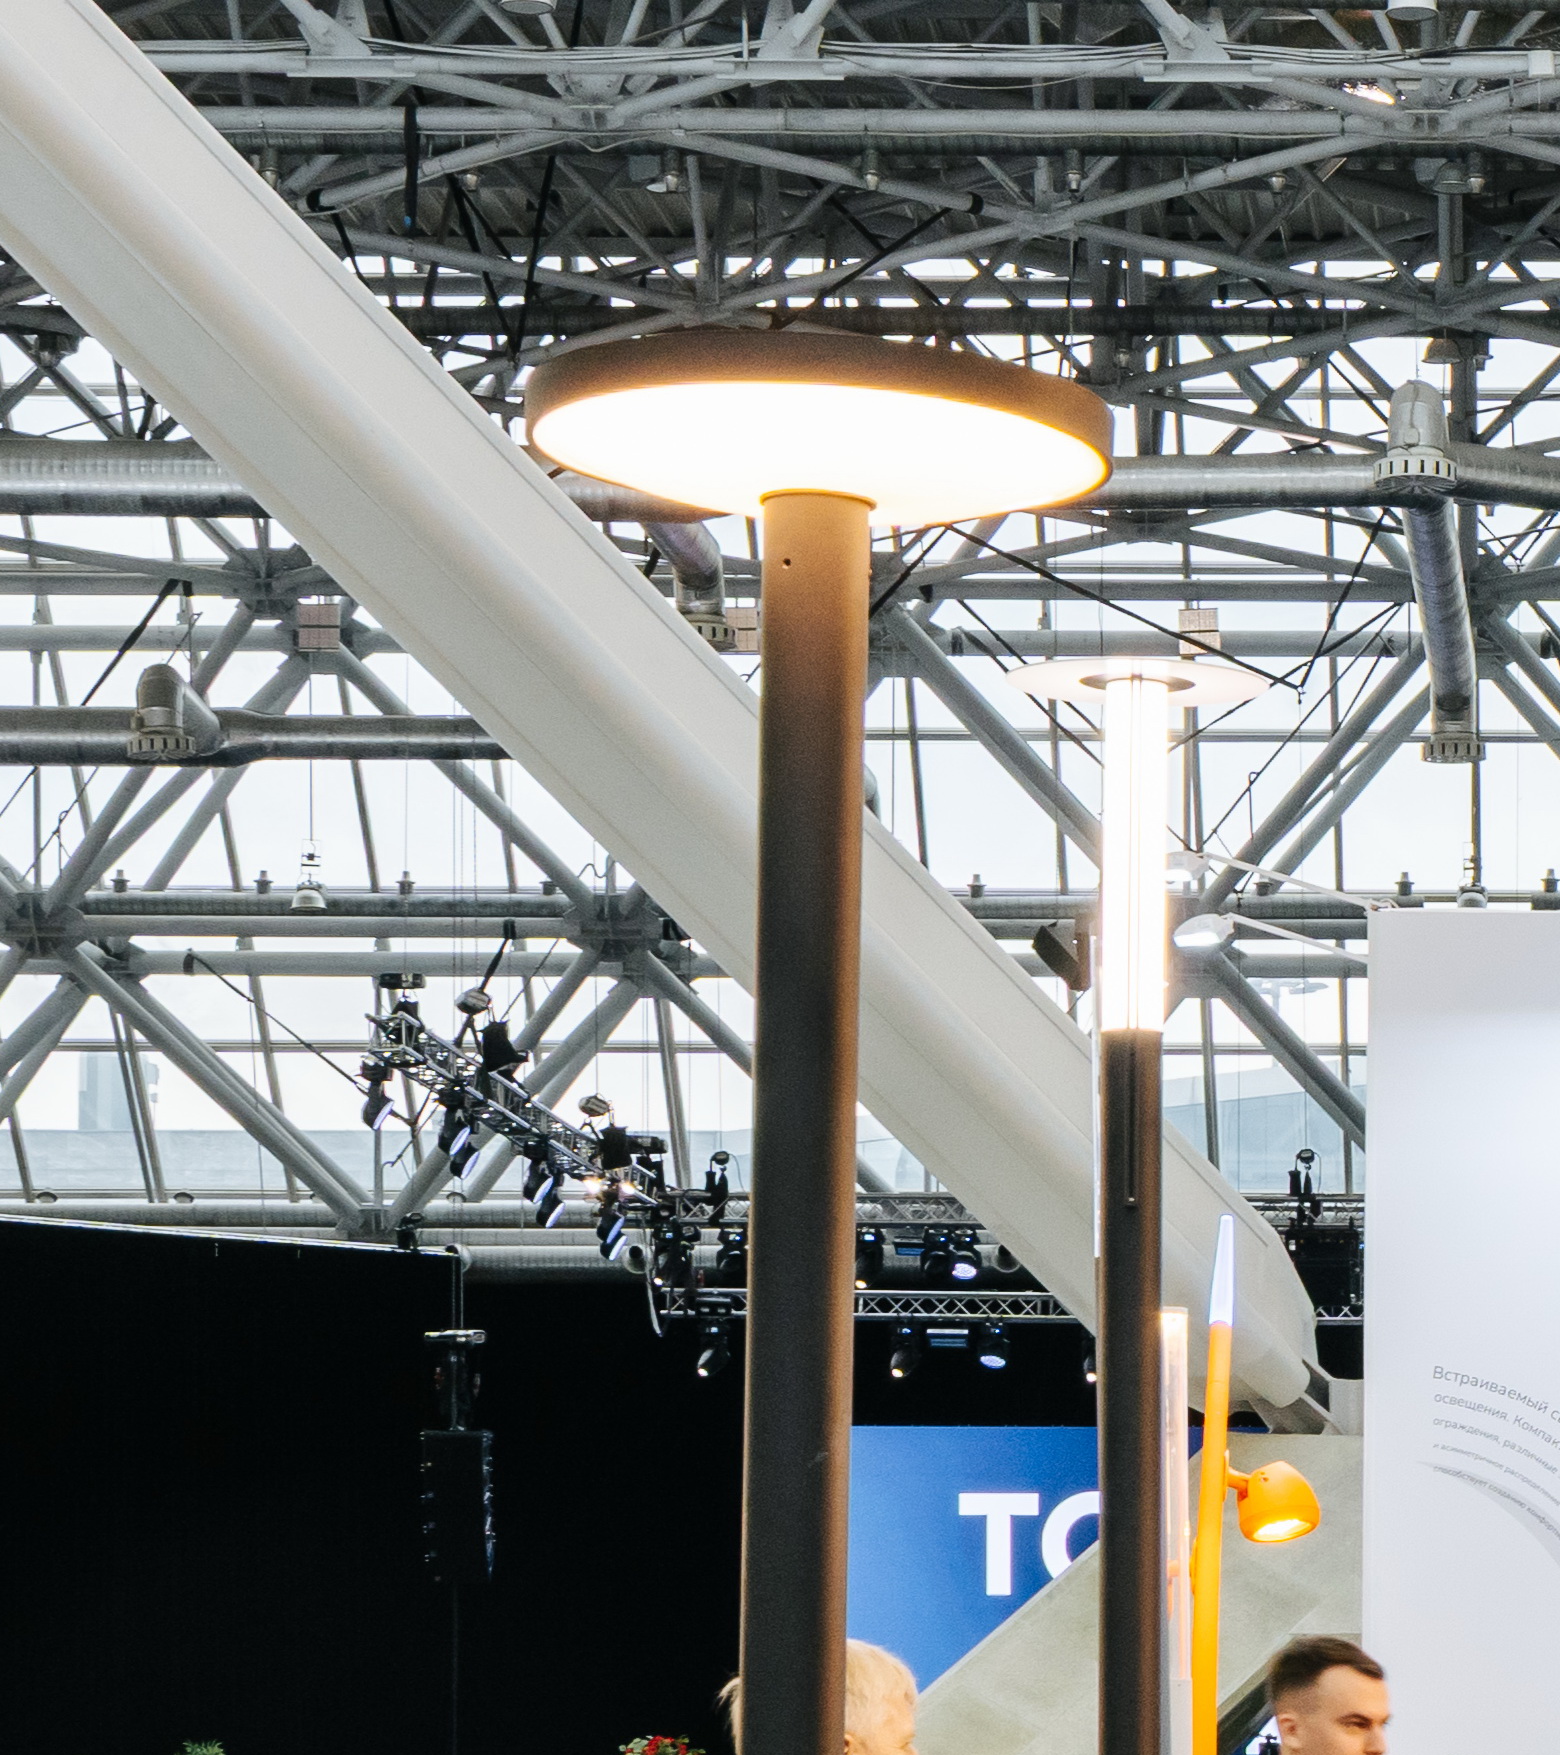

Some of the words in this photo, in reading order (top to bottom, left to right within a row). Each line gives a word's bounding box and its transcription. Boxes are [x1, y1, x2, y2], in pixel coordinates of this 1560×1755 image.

[1432, 1365, 1549, 1414] Встраиваемый
[1433, 1393, 1510, 1423] освещения.
[1502, 1438, 1559, 1475] различные
